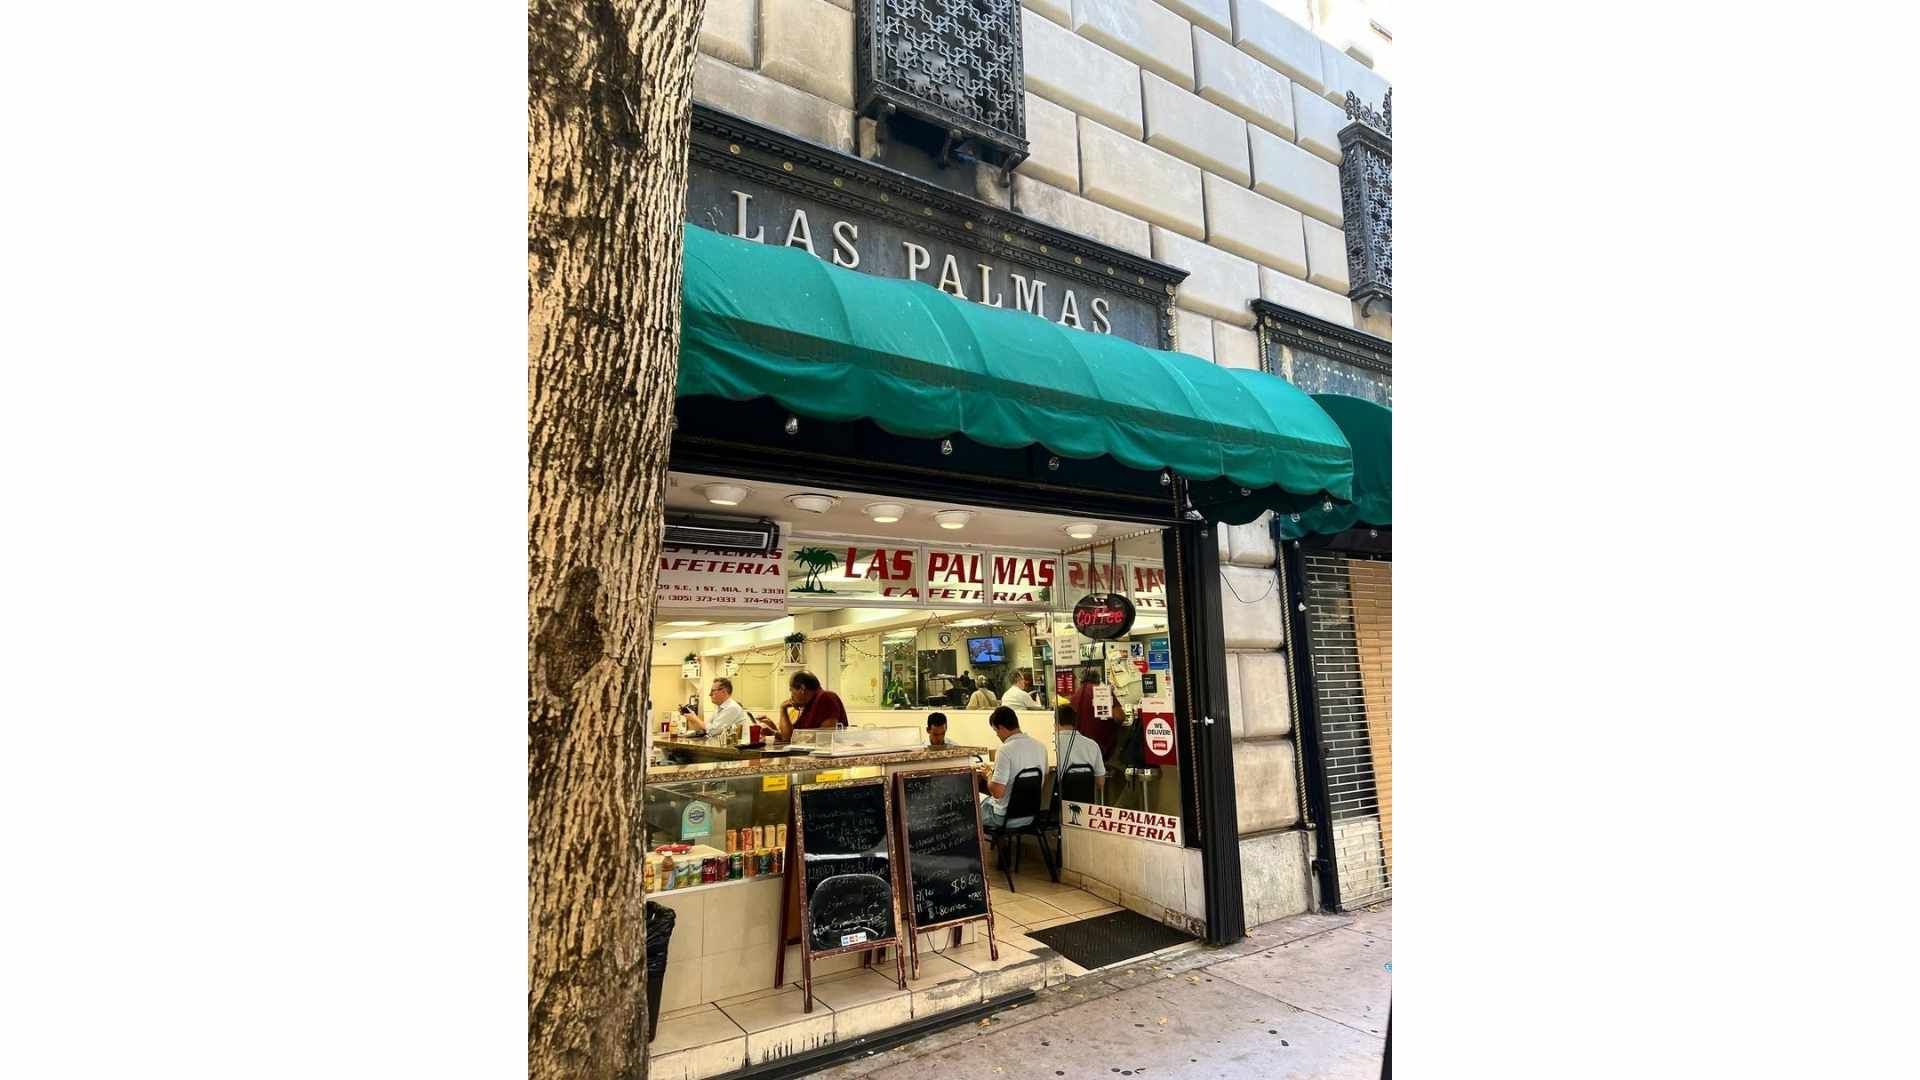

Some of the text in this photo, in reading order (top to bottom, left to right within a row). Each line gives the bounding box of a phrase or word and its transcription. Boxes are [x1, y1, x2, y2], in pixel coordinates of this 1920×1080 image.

[731, 190, 1113, 335] LAS PALMAS
[844, 547, 1057, 587] LAS PALMAS
[883, 587, 1034, 602] CAFETERIA
[1076, 607, 1125, 626] Coffee
[1087, 805, 1177, 829] LAS PALMAS
[1088, 818, 1176, 843] CAFETERIA
